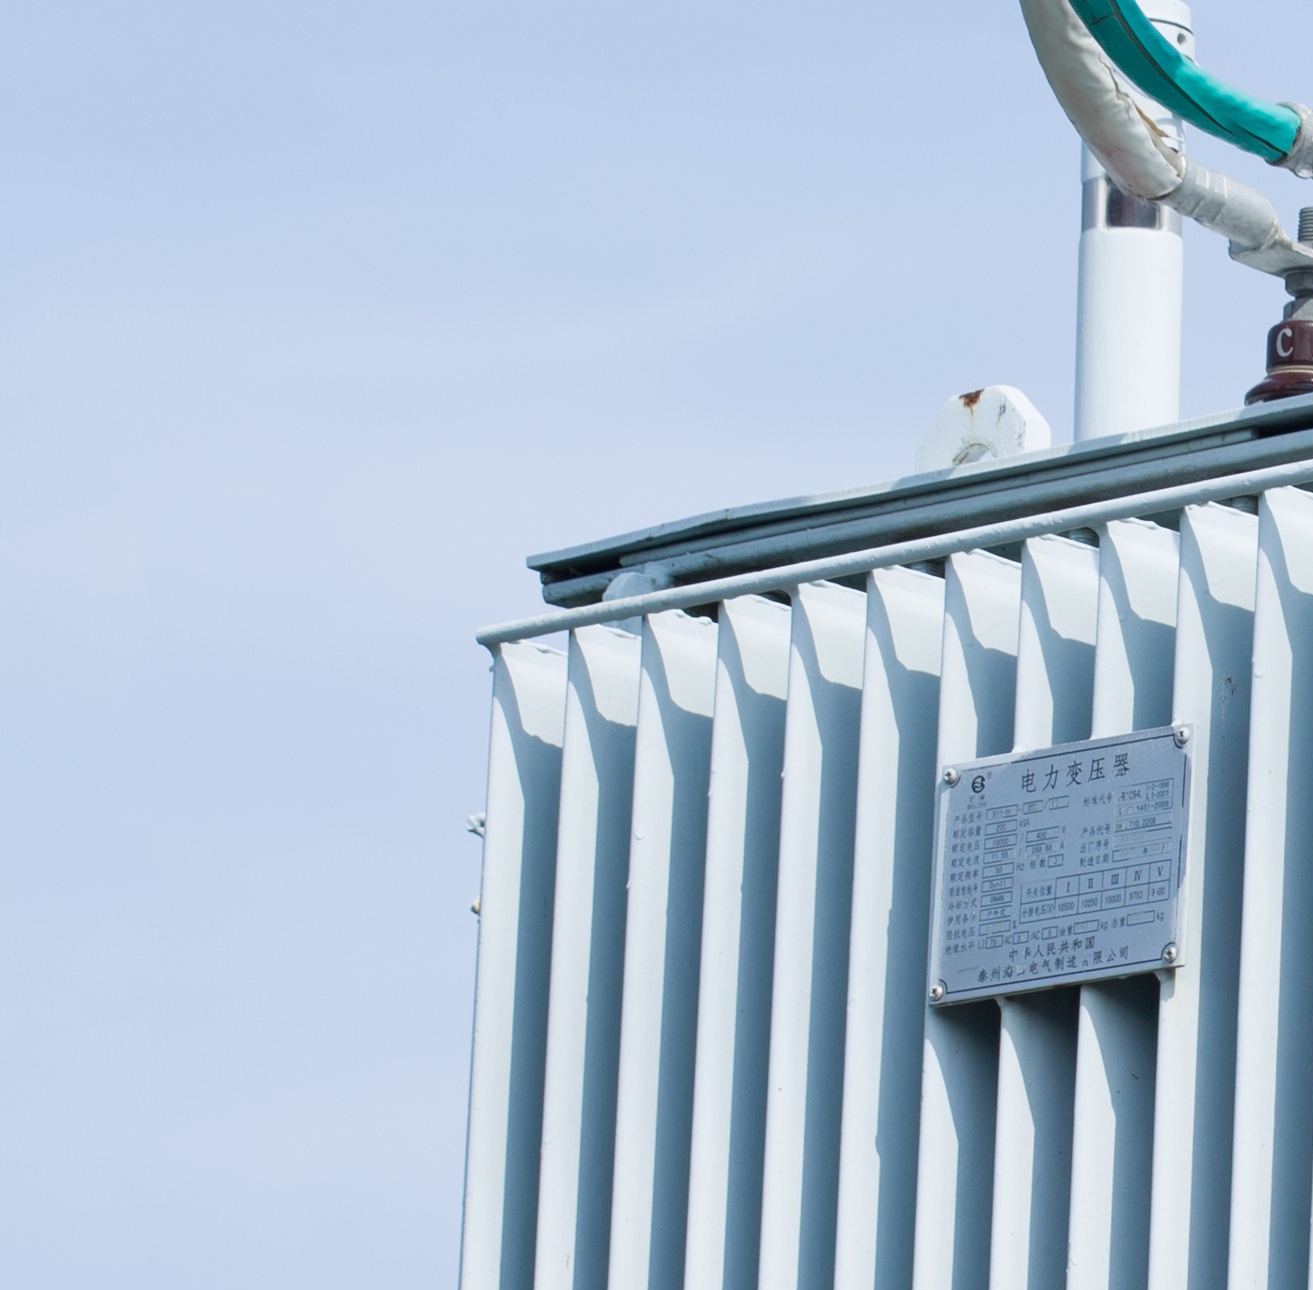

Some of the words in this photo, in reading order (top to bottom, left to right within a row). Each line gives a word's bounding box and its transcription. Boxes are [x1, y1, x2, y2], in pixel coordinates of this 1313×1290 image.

[1021, 753, 1130, 793] 电力变压器
[1157, 865, 1163, 877] V
[977, 946, 1129, 983] 泰州海电气制造有限公司
